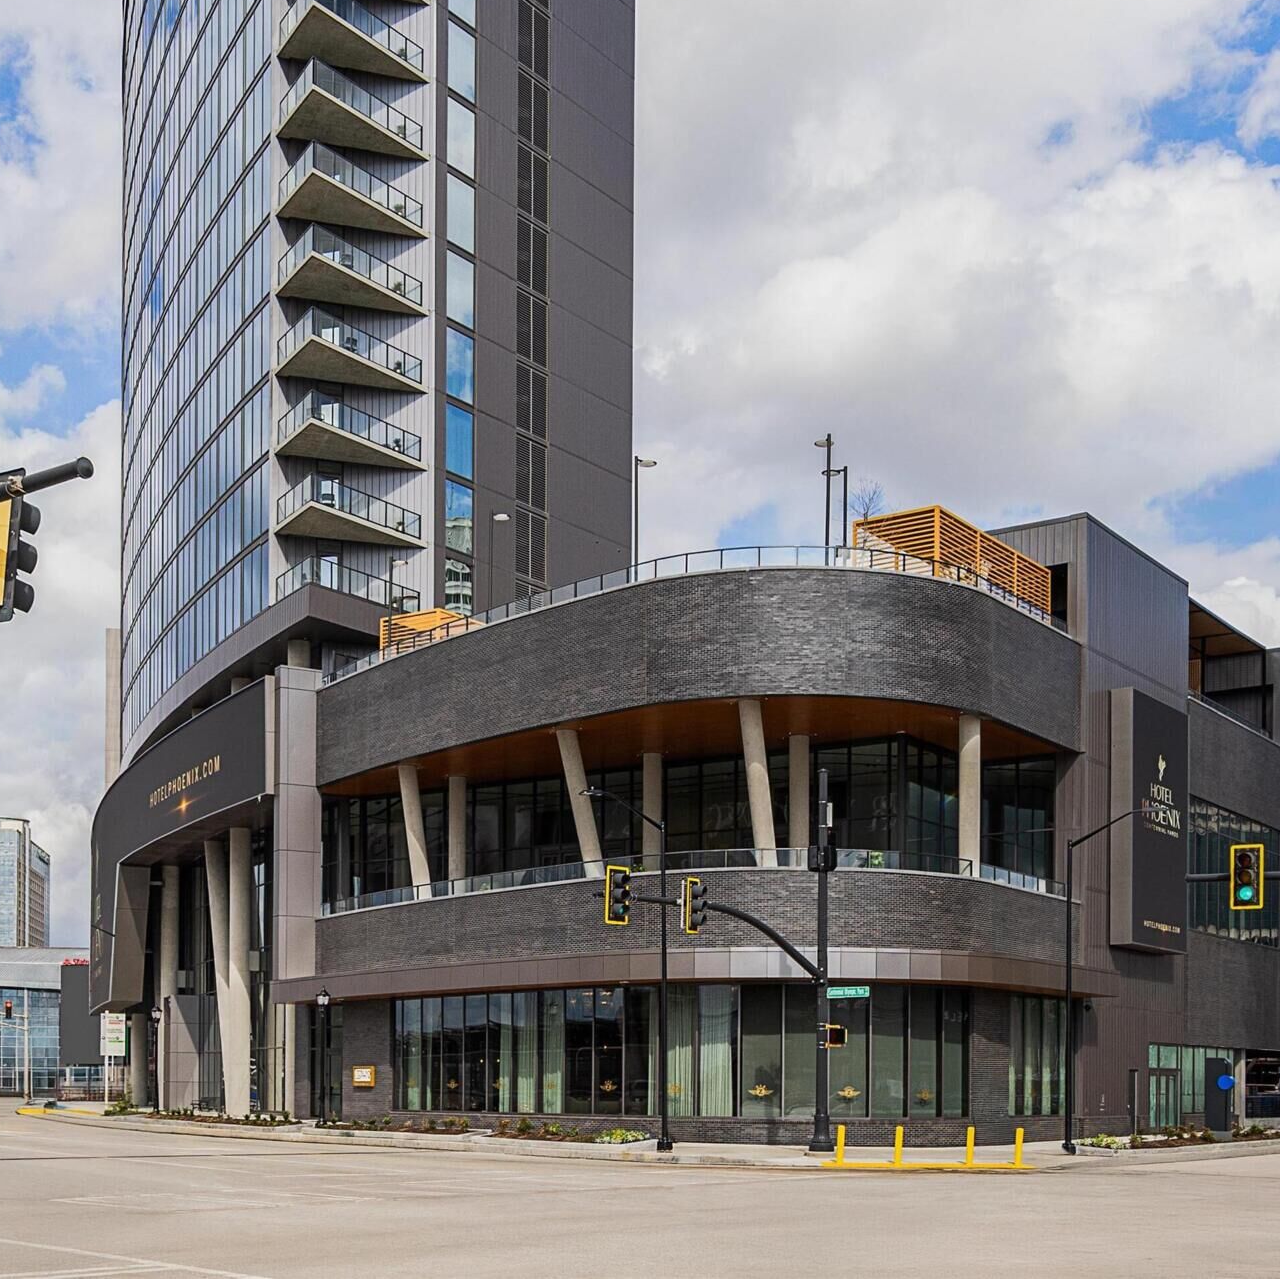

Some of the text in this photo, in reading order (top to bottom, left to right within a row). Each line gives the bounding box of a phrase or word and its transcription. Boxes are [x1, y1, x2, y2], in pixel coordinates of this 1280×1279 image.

[149, 754, 220, 809] HOTELPHOENIX.COM
[1150, 782, 1174, 806] HOTEL
[1142, 798, 1181, 830] PHOENIX
